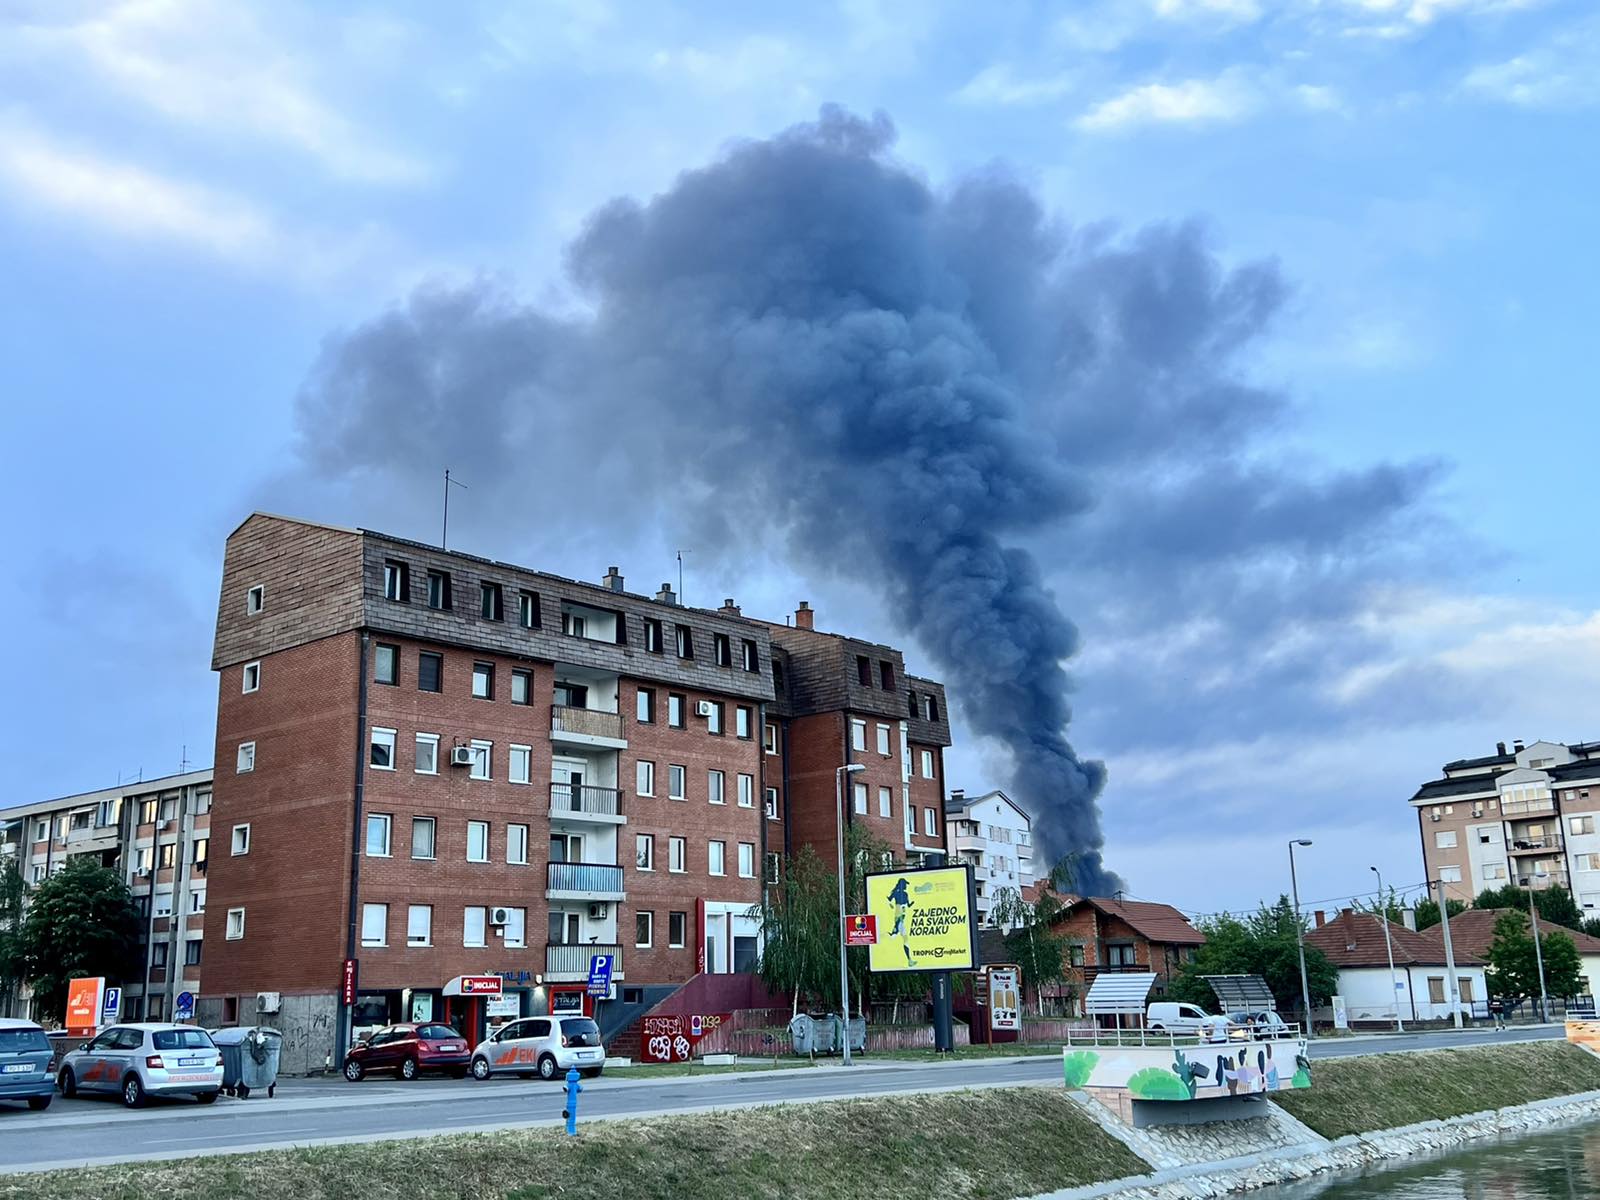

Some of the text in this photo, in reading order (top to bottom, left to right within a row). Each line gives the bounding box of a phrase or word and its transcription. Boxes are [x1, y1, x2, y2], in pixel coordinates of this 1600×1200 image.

[912, 906, 958, 918] ZAJEDNO
[911, 915, 966, 927] NA SVAKOM
[909, 925, 949, 937] KORAKU
[912, 949, 934, 957] TROPIC
[594, 956, 607, 974] P
[107, 990, 116, 1007] P
